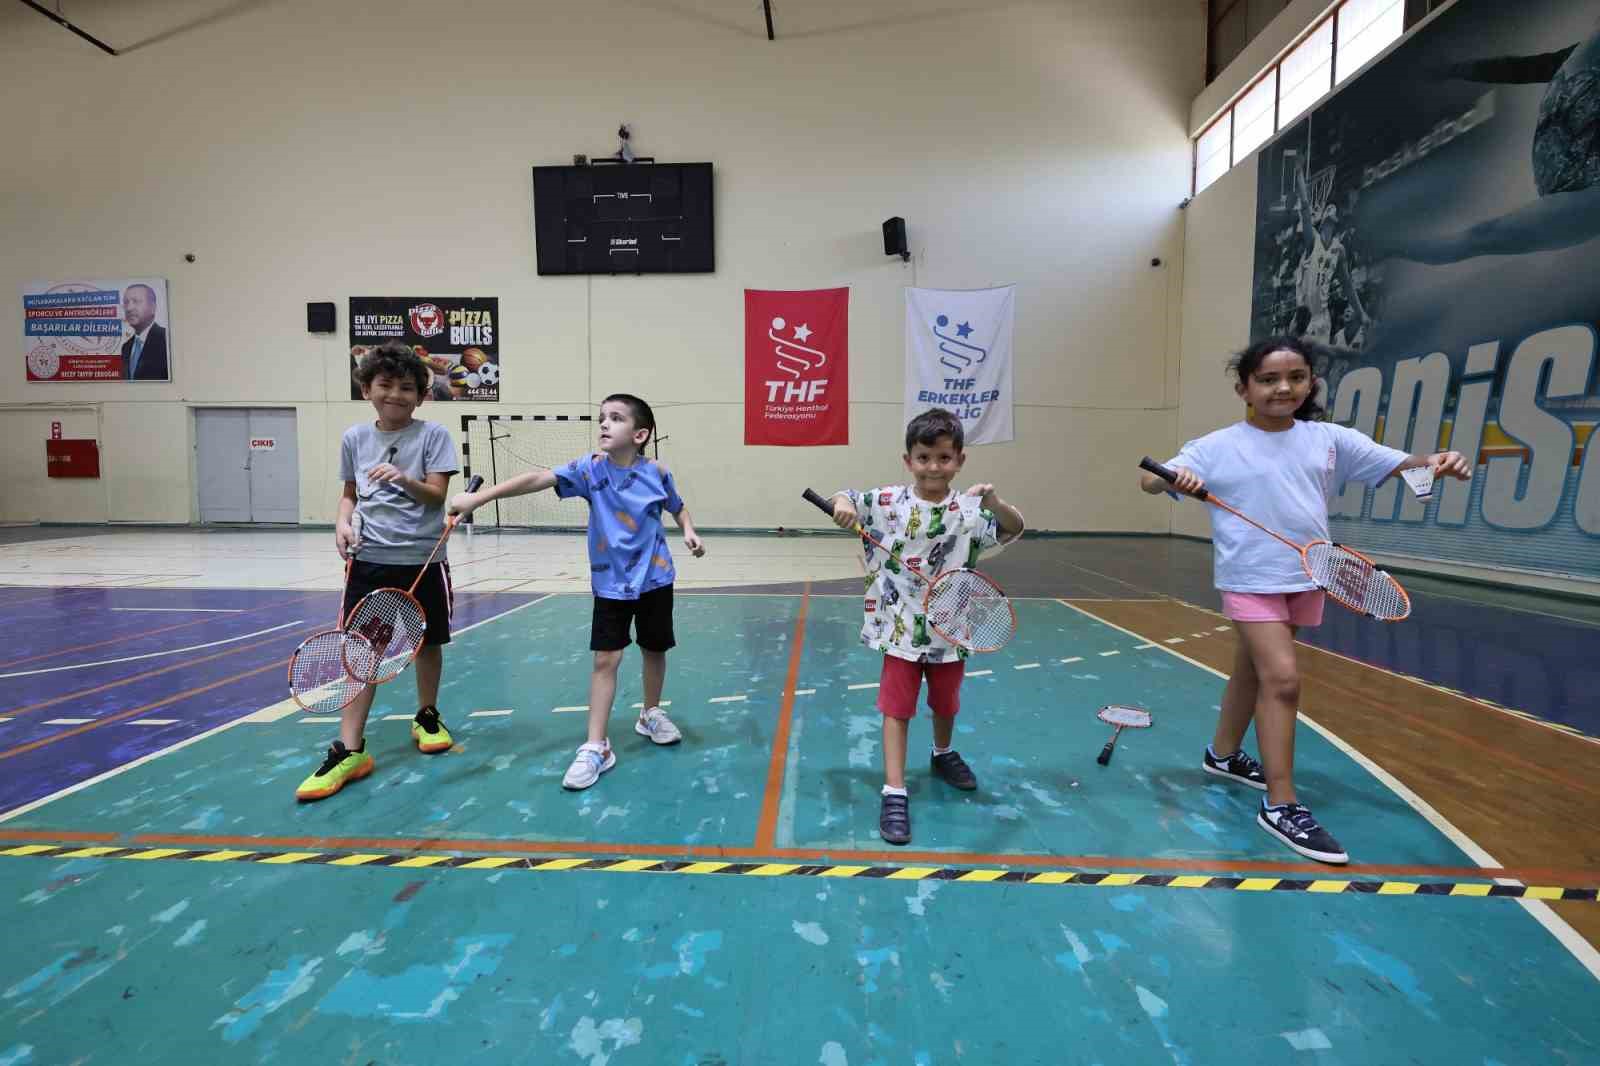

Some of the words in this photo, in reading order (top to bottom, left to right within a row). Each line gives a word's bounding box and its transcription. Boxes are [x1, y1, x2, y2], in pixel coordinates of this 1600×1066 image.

[354, 315, 366, 324] EN
[31, 322, 80, 334] BAŞARILAR
[82, 321, 120, 333] DİLERİM
[450, 326, 493, 345] BULLS
[943, 378, 976, 390] THF
[765, 380, 828, 402] THF
[918, 389, 1000, 405] ERKEKLER
[765, 404, 794, 413] Türkiye
[251, 439, 274, 448] ÇIKIŞ
